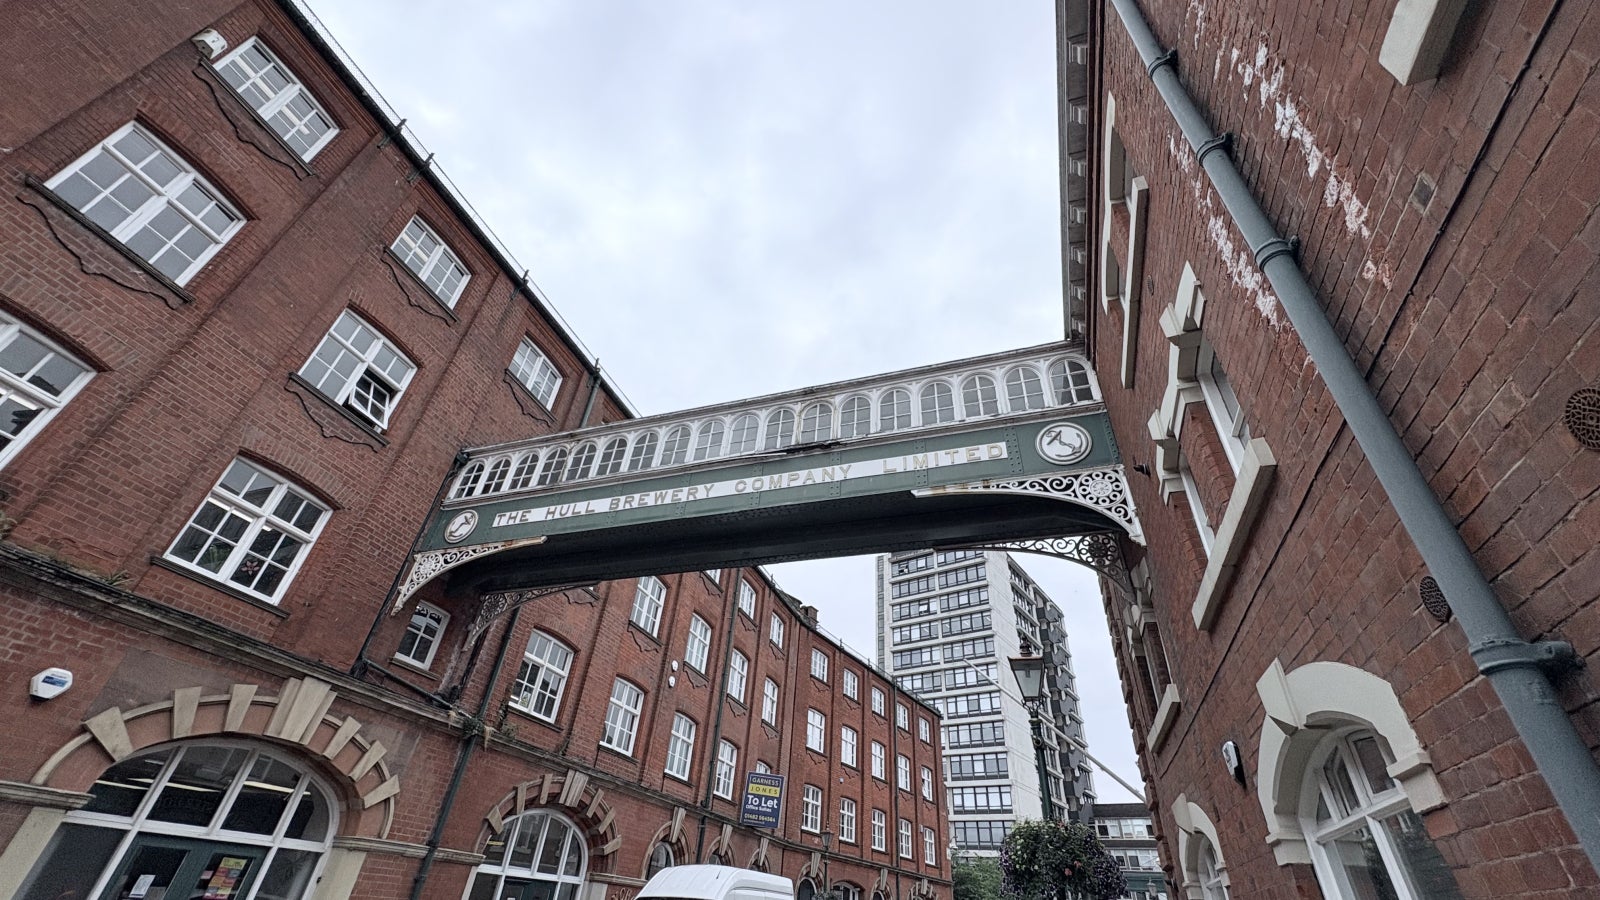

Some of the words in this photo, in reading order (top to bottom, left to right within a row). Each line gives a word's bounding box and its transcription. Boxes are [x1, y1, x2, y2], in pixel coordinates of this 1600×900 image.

[496, 510, 532, 525] THE
[545, 501, 595, 519] HULL
[609, 484, 715, 511] BREWERY
[734, 465, 852, 493] COMPANY
[882, 443, 1003, 473] LIMITED
[751, 777, 779, 786] GARNESS
[750, 786, 778, 794] JONES
[747, 795, 759, 805] To
[761, 797, 778, 808] Let
